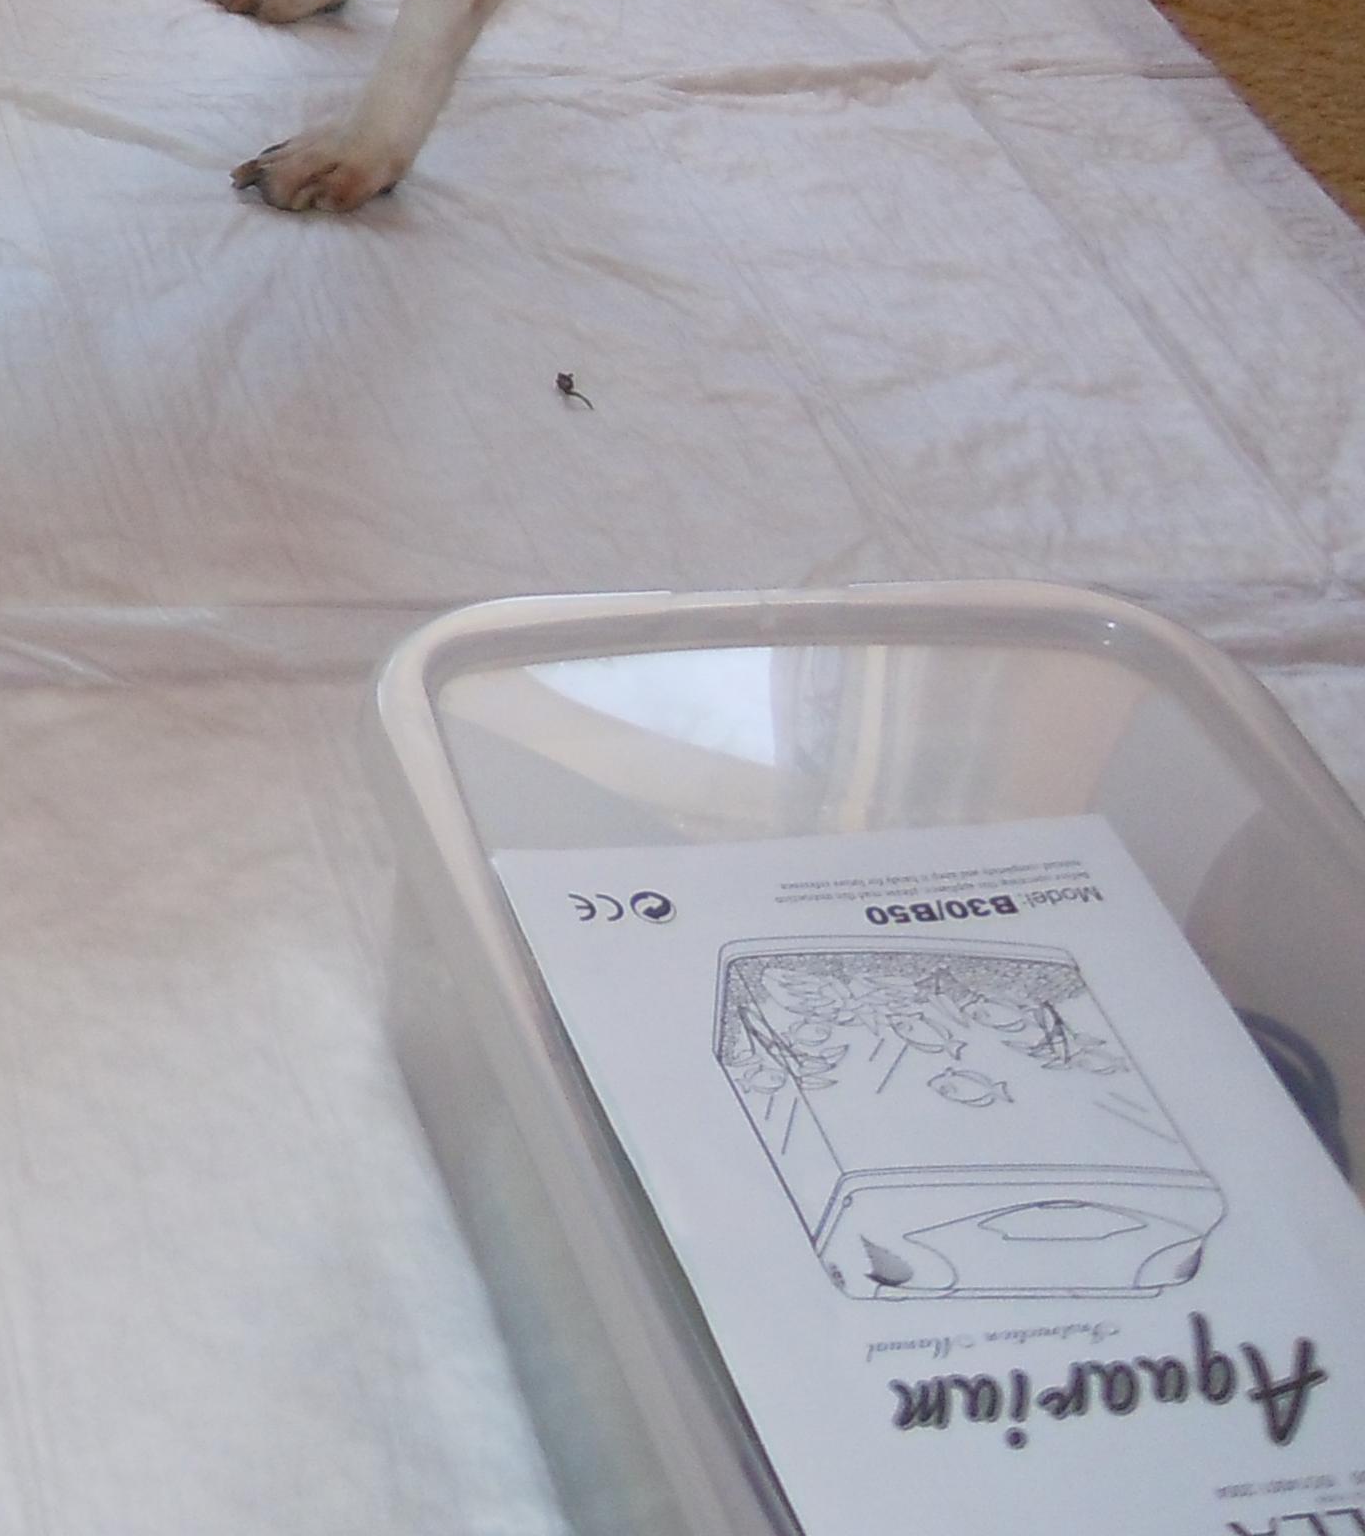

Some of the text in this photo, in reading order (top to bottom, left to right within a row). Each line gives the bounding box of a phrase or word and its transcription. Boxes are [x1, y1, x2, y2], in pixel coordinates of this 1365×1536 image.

[865, 886, 1105, 926] Model: B30/B50
[888, 1310, 1329, 1450] Aquarium
